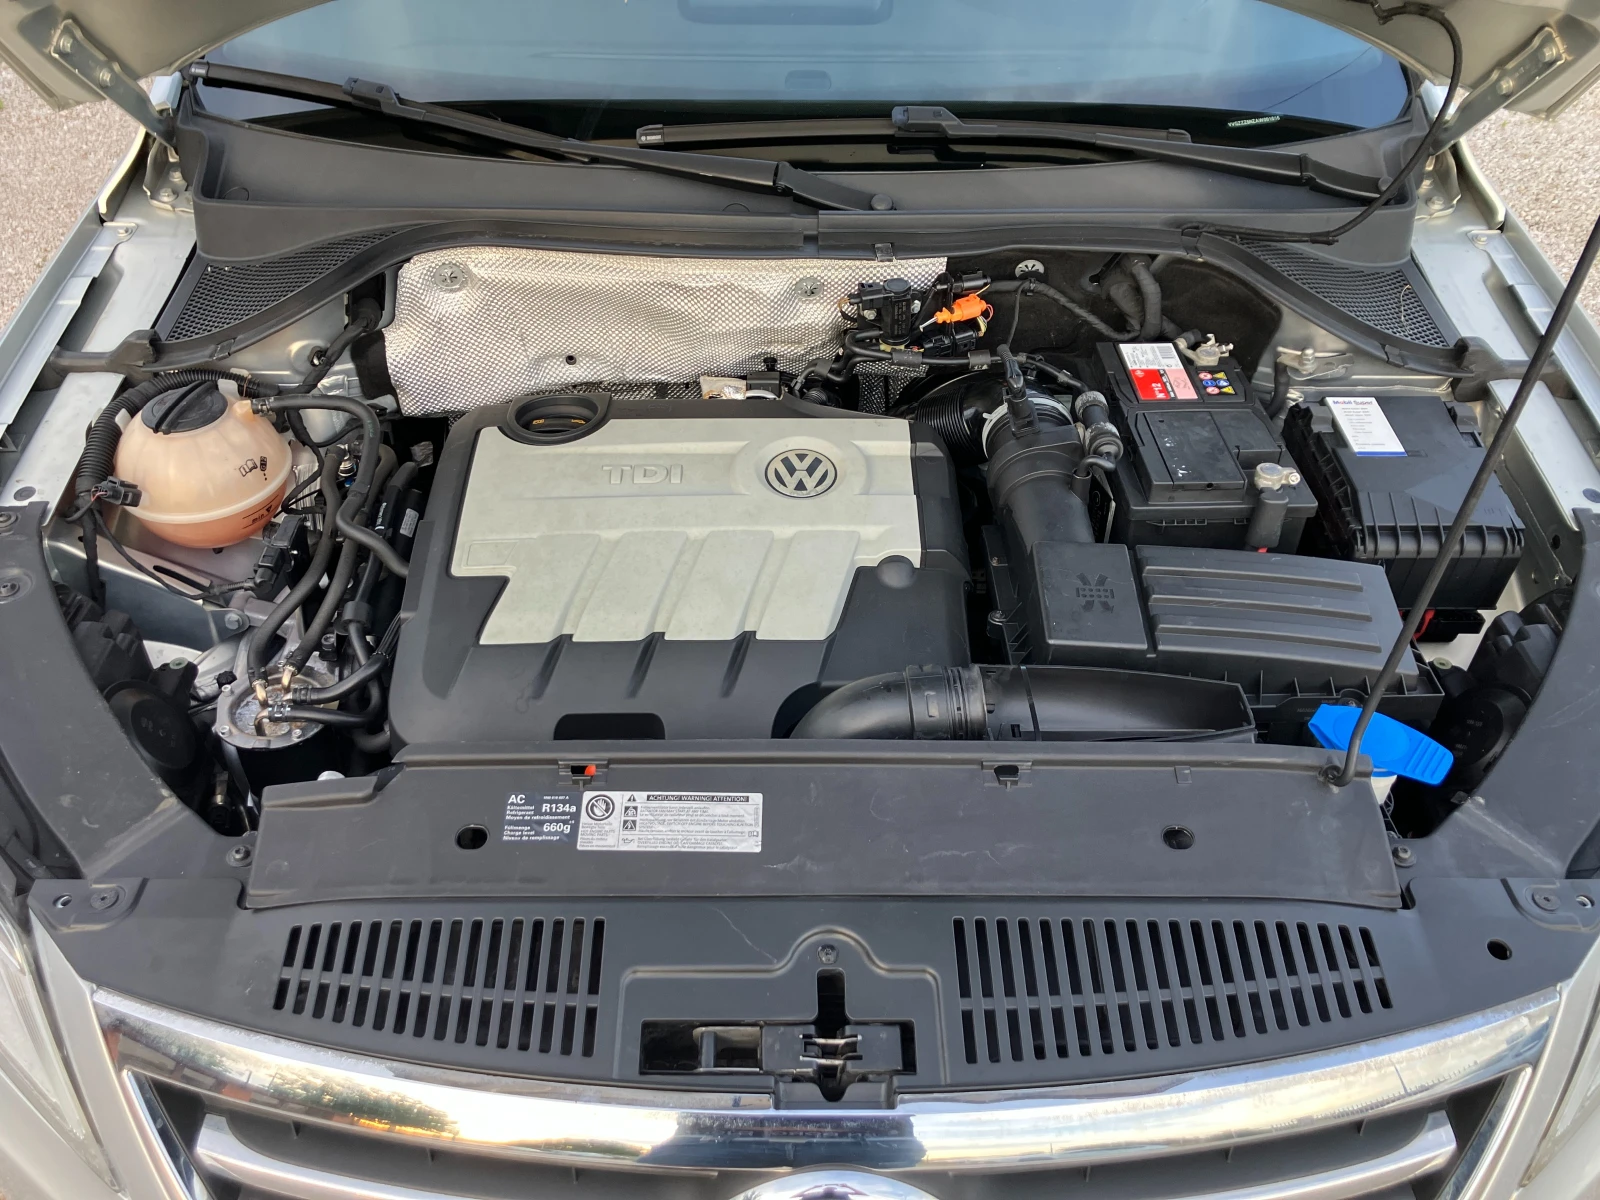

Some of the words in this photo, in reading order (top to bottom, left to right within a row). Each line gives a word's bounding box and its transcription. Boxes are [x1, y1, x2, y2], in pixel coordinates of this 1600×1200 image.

[602, 463, 684, 485] TDI
[251, 513, 265, 524] min
[508, 794, 526, 804] AC
[542, 803, 577, 813] R134a
[543, 822, 571, 834] 660g
